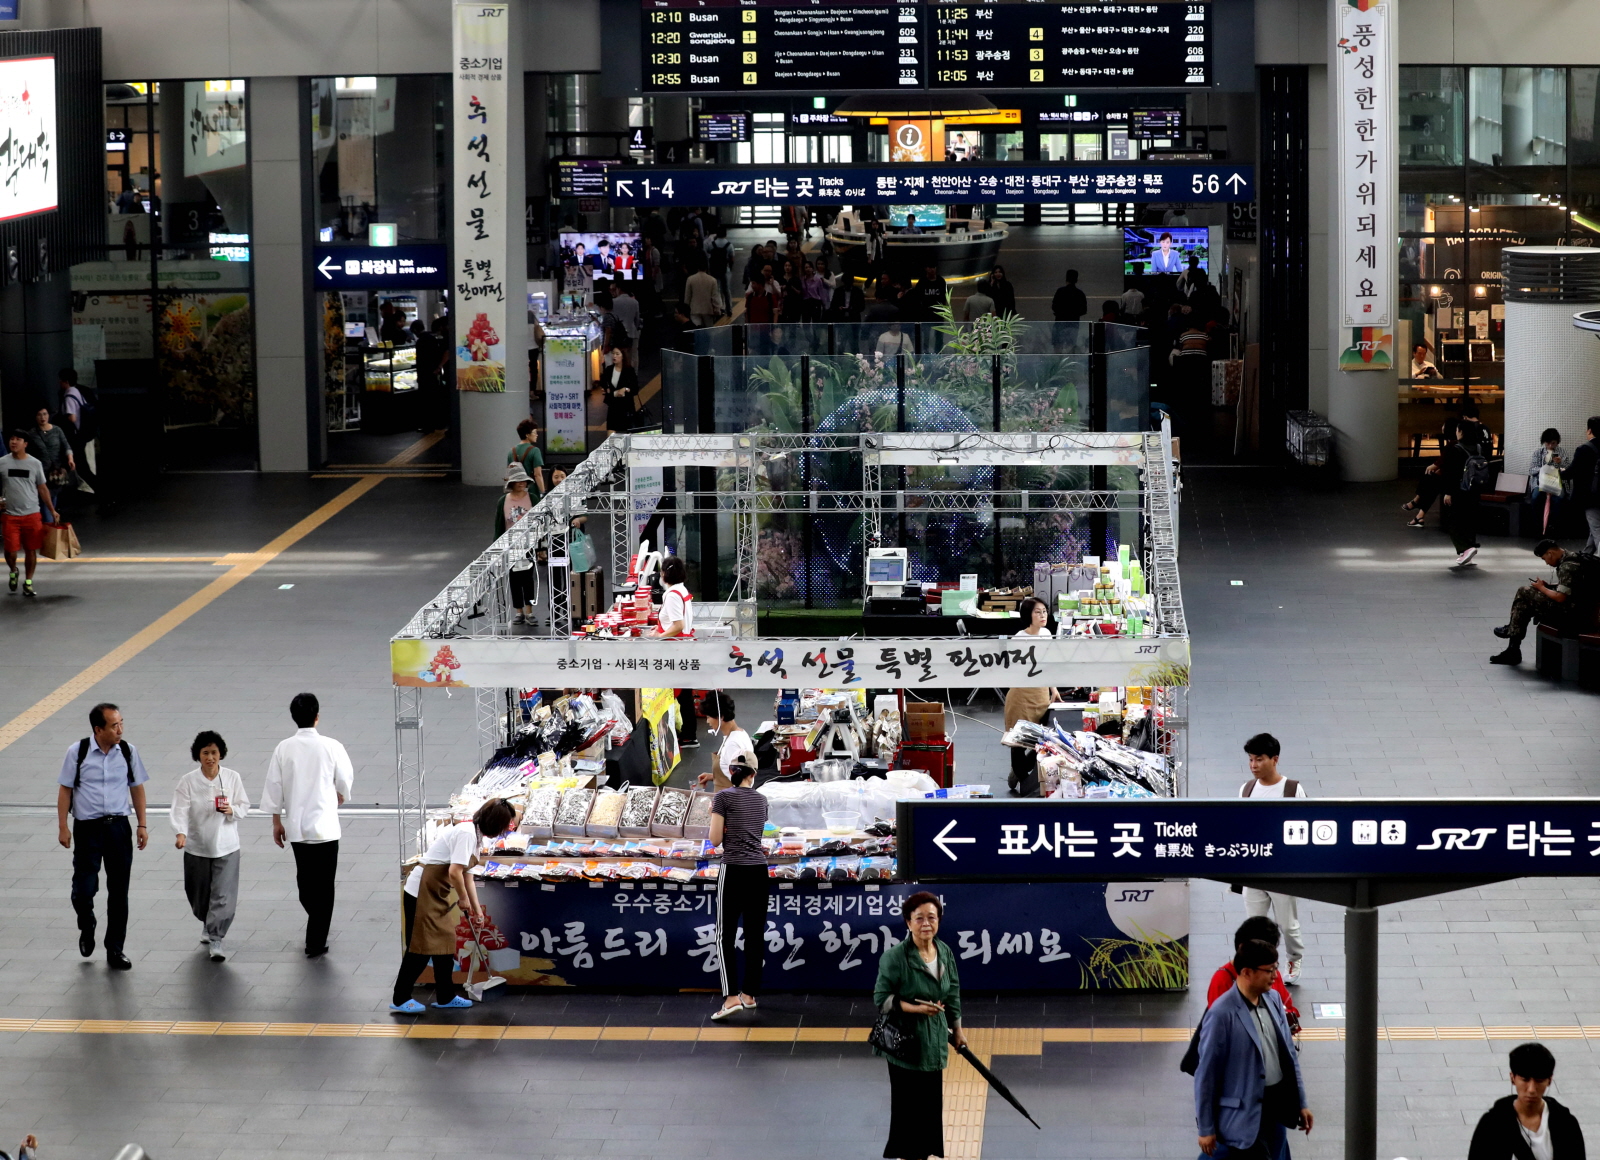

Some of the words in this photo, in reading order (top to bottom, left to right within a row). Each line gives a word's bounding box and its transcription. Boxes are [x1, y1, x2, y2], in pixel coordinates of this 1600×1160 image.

[477, 8, 505, 18] SRT
[899, 7, 916, 16] 329
[937, 8, 968, 19] 11:25
[975, 9, 994, 19] 부산
[1187, 5, 1204, 14] 318
[651, 12, 682, 23] 12:10
[689, 12, 719, 22] Busan
[899, 28, 916, 36] 609
[937, 29, 968, 40] 11:44
[975, 29, 994, 40] 부산
[1187, 26, 1204, 34] 320
[651, 32, 681, 43] 12:20
[900, 49, 915, 57] 331
[937, 50, 969, 61] 11:53
[975, 50, 1011, 61] 광주송정
[1187, 46, 1204, 55] 608
[459, 57, 503, 71] 중소기업
[651, 53, 681, 64] 12:30
[689, 54, 719, 63] Busan
[1187, 67, 1204, 76] 322
[1352, 23, 1377, 111] 풍성한
[900, 69, 916, 77] 333
[937, 70, 967, 81] 12:05
[976, 70, 995, 81] 부산
[651, 74, 681, 85] 12:55
[690, 74, 720, 84] Busan
[467, 95, 490, 164] 추석
[634, 129, 643, 144] 4
[666, 146, 676, 162] 4
[1354, 118, 1378, 206] 한가위
[818, 176, 844, 186] Tracks
[876, 176, 897, 188] 동탄
[904, 176, 925, 188] 지제
[931, 176, 972, 188] 천안아산
[978, 175, 998, 187] 오송
[1004, 175, 1025, 187] 대전
[1030, 175, 1062, 187] 동대구
[1068, 174, 1090, 187] 부산
[1095, 174, 1137, 187] 광주송정
[1142, 174, 1164, 187] 목포
[711, 181, 752, 195] SRT
[754, 177, 790, 198] 타는
[795, 177, 814, 198] 곳
[844, 188, 865, 197] のりば
[466, 170, 492, 241] 선물
[188, 209, 199, 231] 3
[1355, 213, 1378, 298] 되세요
[361, 259, 397, 274] 화장실
[462, 259, 494, 282] 특별
[457, 281, 505, 303] 판매전
[1350, 341, 1382, 351] SRT
[1134, 644, 1161, 654] SRT
[556, 658, 602, 670] 중소기업
[615, 658, 649, 671] 사회적
[652, 658, 675, 671] 경제
[678, 658, 701, 671] 상품
[727, 644, 787, 680] 추석
[802, 646, 862, 685] 선물
[875, 645, 938, 683] 특별
[946, 644, 1043, 677] 판매전
[1154, 821, 1198, 838] Ticket
[998, 821, 1098, 858] 표사는
[1110, 822, 1144, 858] 곳
[1416, 827, 1498, 850] SRT
[1507, 820, 1576, 857] 타는
[1154, 843, 1195, 858] 售票处
[1204, 842, 1273, 857] きっぷうりば
[1114, 889, 1155, 903] SRT
[818, 921, 912, 971] 한가
[957, 927, 1072, 965] 되세요
